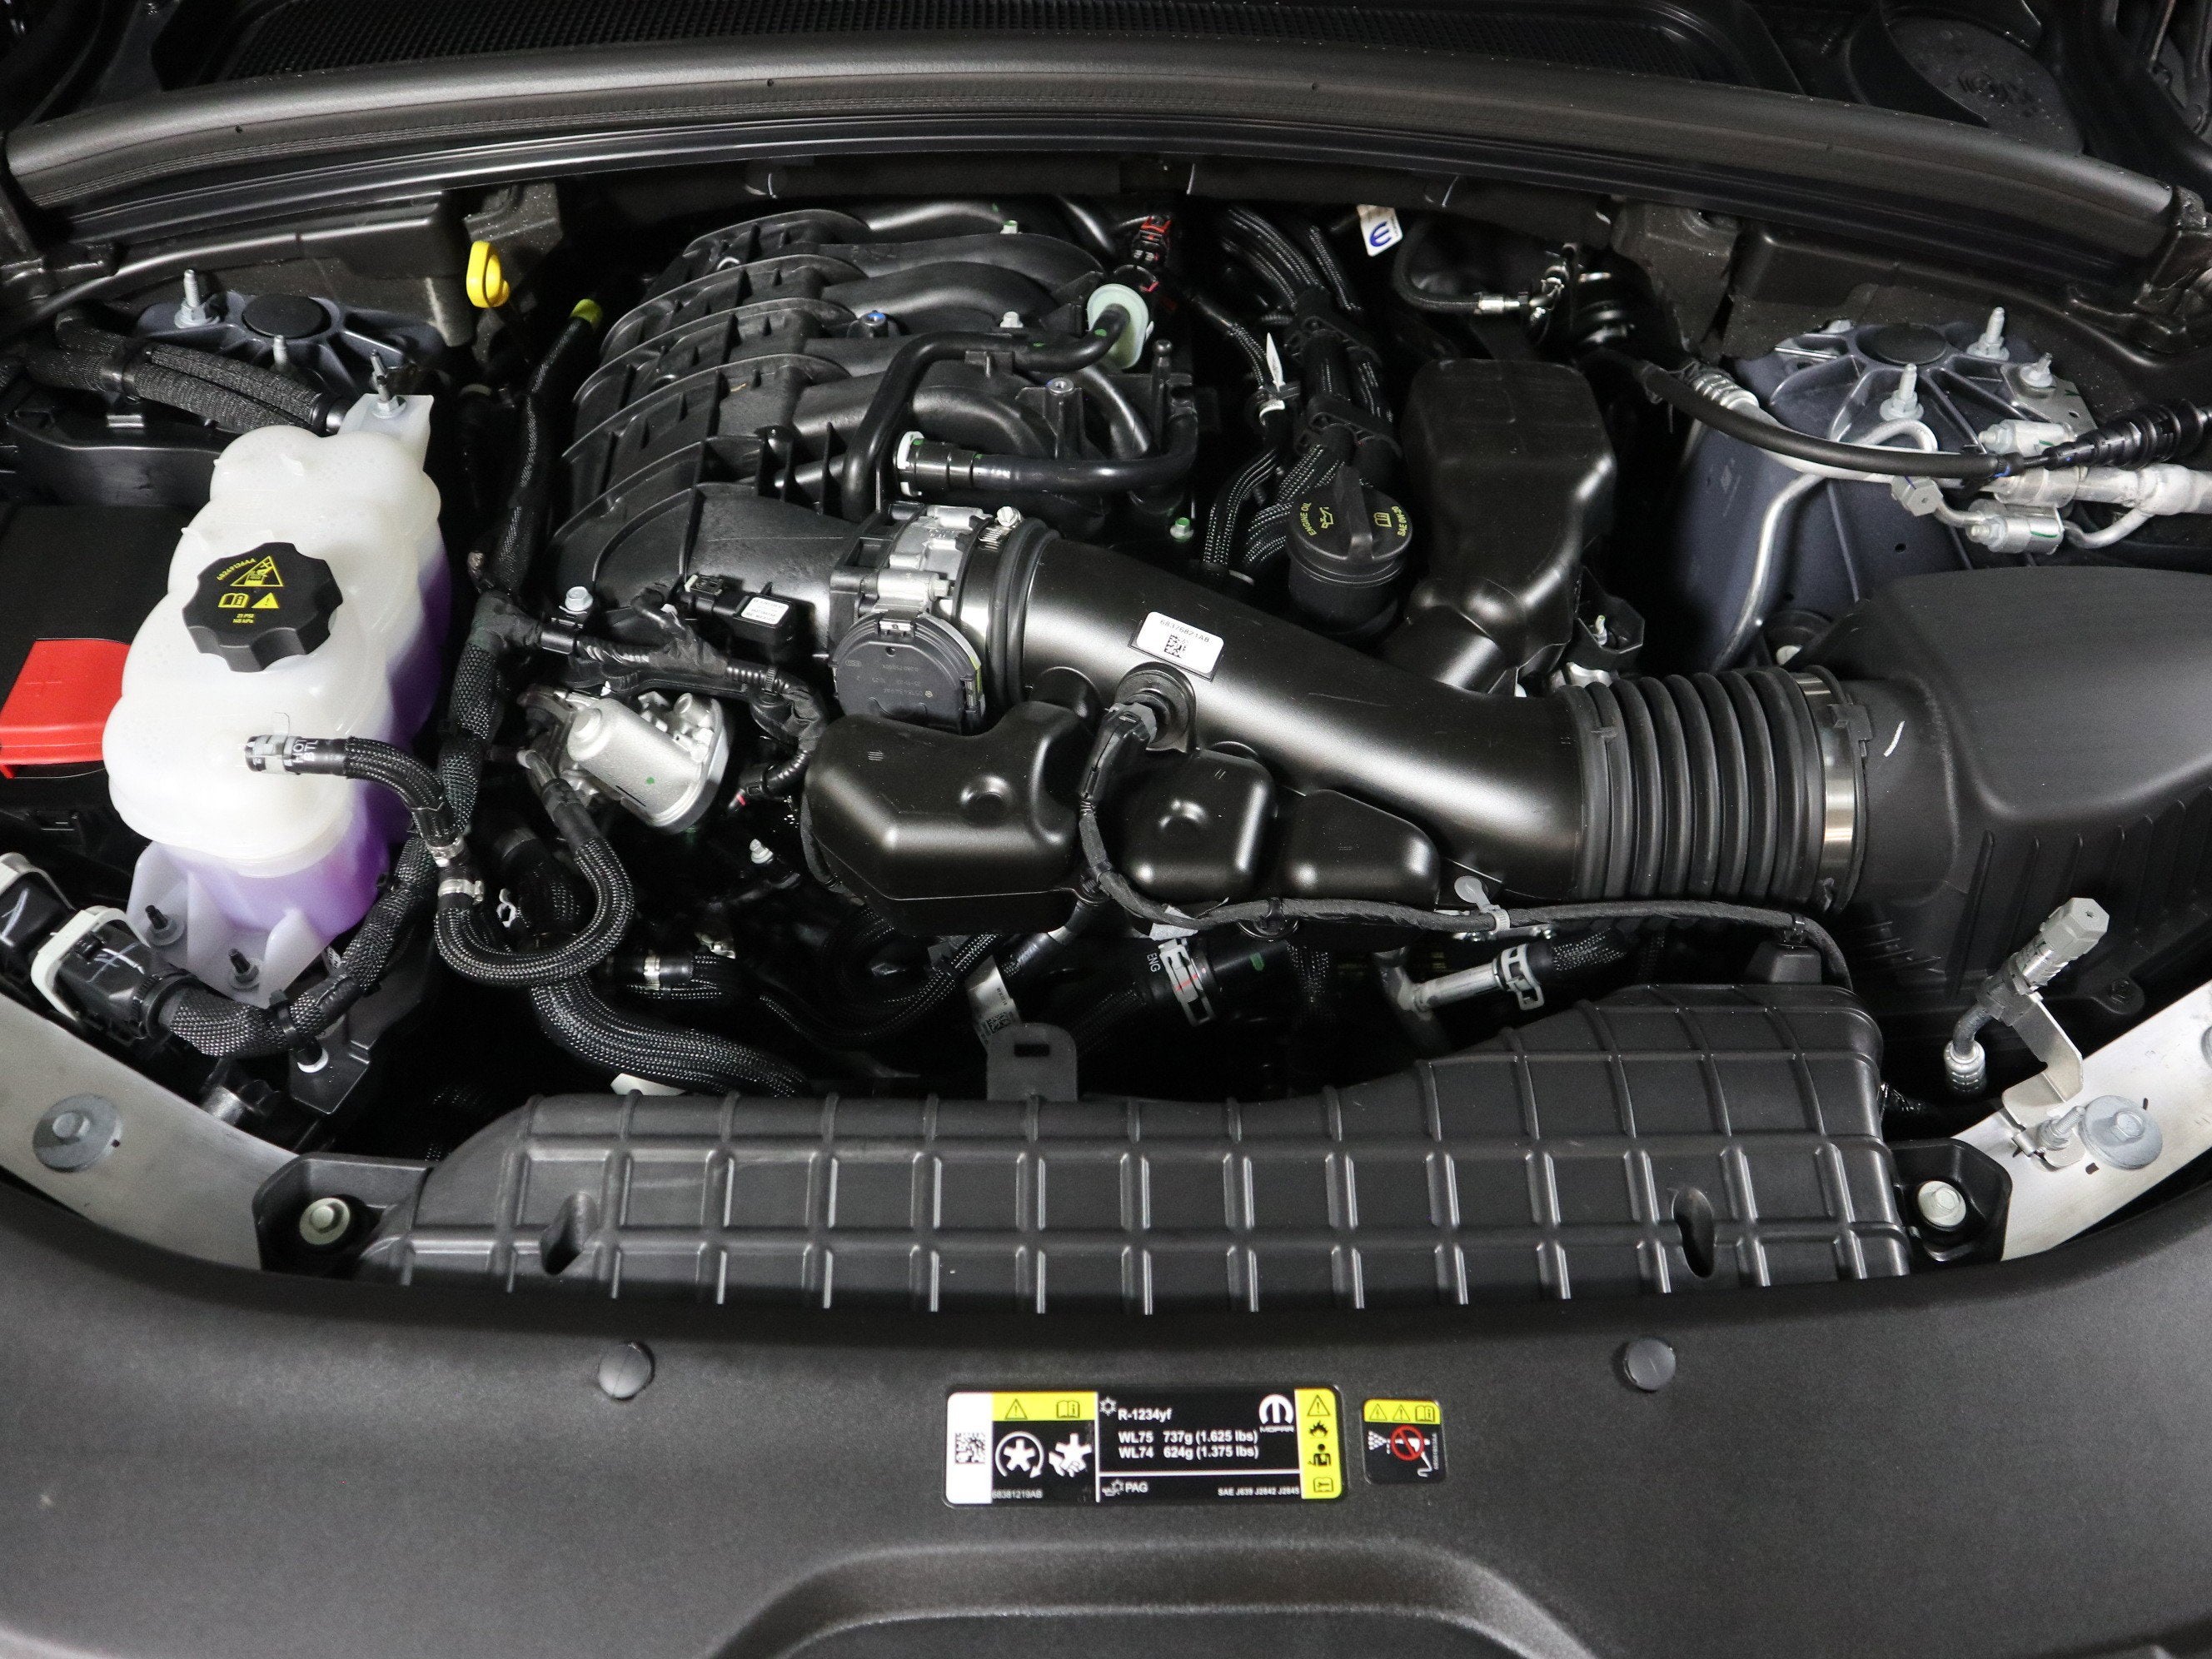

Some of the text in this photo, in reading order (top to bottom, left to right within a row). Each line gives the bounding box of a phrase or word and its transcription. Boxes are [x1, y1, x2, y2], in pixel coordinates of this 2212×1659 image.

[1300, 502, 1318, 536] ENGINE OIL
[1397, 523, 1407, 536] SAE
[1146, 952, 1161, 973] ENG
[1117, 1407, 1173, 1423] R-1234yf
[1259, 1425, 1295, 1433] MOPAR
[1118, 1429, 1258, 1446] WL75 737g (1.625 lbs)
[1118, 1445, 1259, 1461] WL74 624g (1.375 lbs)
[1125, 1481, 1148, 1493] PAG
[1218, 1487, 1234, 1496] SAE
